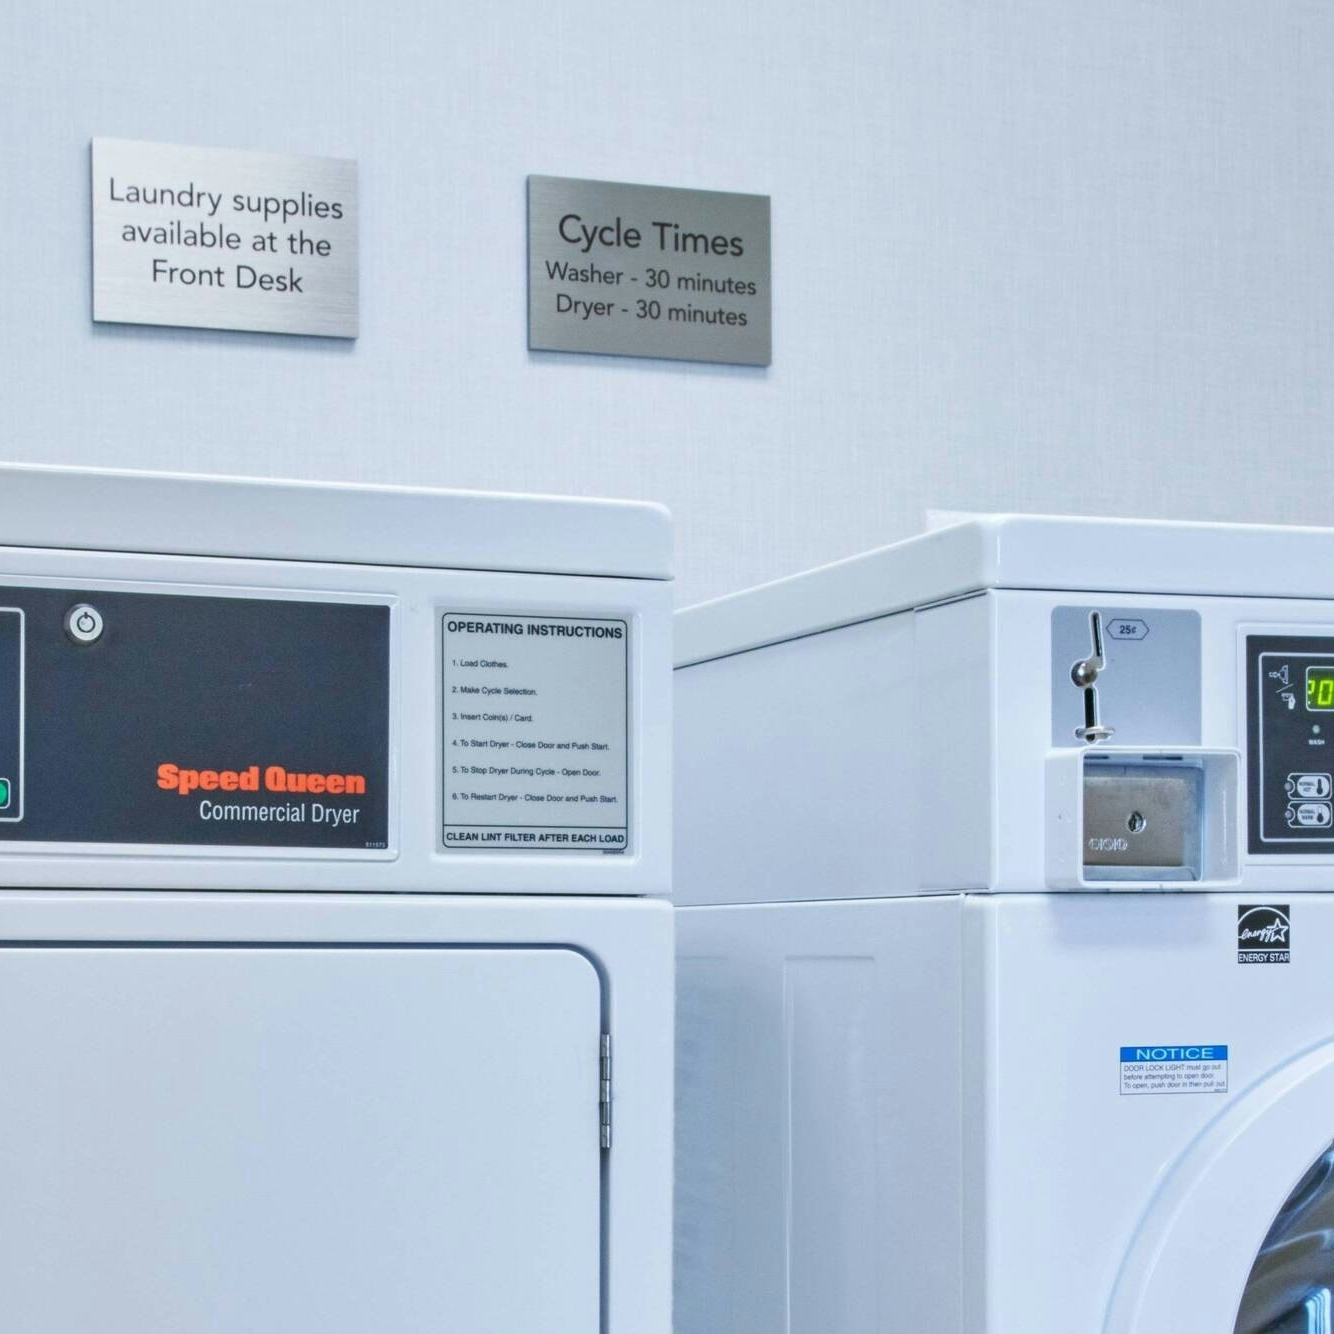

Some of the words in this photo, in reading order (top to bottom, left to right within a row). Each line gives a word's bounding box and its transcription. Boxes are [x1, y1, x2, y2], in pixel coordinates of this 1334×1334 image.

[109, 177, 222, 217] Laundry
[233, 189, 344, 224] supplies
[121, 221, 242, 253] available
[252, 225, 277, 255] at
[288, 229, 332, 259] the
[557, 212, 643, 256] Cycle
[651, 219, 744, 260] Times
[152, 259, 224, 290] Front
[236, 263, 304, 295] Desk
[544, 259, 624, 289] Washer
[645, 267, 671, 292] 30
[676, 270, 758, 298] minutes
[555, 293, 614, 322] Dryer
[635, 298, 661, 323] 30
[668, 302, 749, 329] minutes
[447, 621, 524, 635] OPERATING
[527, 623, 623, 639] INSTRUCTIONS
[460, 659, 478, 668] Load
[480, 660, 509, 669] Clothes.
[460, 686, 480, 695] Make
[481, 687, 502, 696] Cycle
[503, 687, 538, 696] Selection.
[460, 713, 481, 721] Insert
[483, 714, 508, 723] Coin(s)
[509, 714, 513, 722] /
[460, 739, 469, 747] To
[470, 740, 489, 748] Start
[489, 740, 509, 749] Dryer
[515, 740, 536, 749] Close
[538, 741, 555, 749] Door
[557, 742, 570, 750] and
[572, 742, 589, 750] Push
[591, 742, 609, 751] Start.
[157, 763, 260, 794] Speed
[265, 765, 365, 795] Queen
[460, 766, 469, 774] To
[470, 767, 487, 776] Stop
[489, 767, 508, 776] Dryer
[510, 767, 534, 777] During
[535, 768, 555, 777] Cycle
[561, 769, 580, 778] Open
[582, 769, 601, 777] Door.
[461, 793, 469, 801] To
[470, 793, 497, 801] Restart
[498, 794, 518, 803] Dryer
[524, 794, 545, 802] Close
[546, 794, 563, 803] Door
[565, 795, 578, 803] and
[580, 795, 598, 803] Push
[600, 796, 618, 804] Start.
[199, 799, 306, 824] Commercial
[311, 802, 361, 827] Dryer
[446, 832, 479, 841] CLEAN
[481, 832, 502, 842] LINT
[504, 833, 536, 842] FILTER
[538, 833, 569, 842] AFTER
[571, 834, 597, 843] EACH
[599, 834, 624, 843] LOAD
[1238, 953, 1269, 962] ENERGY
[1269, 953, 1290, 962] STAR
[1136, 1048, 1214, 1060] NOTICE
